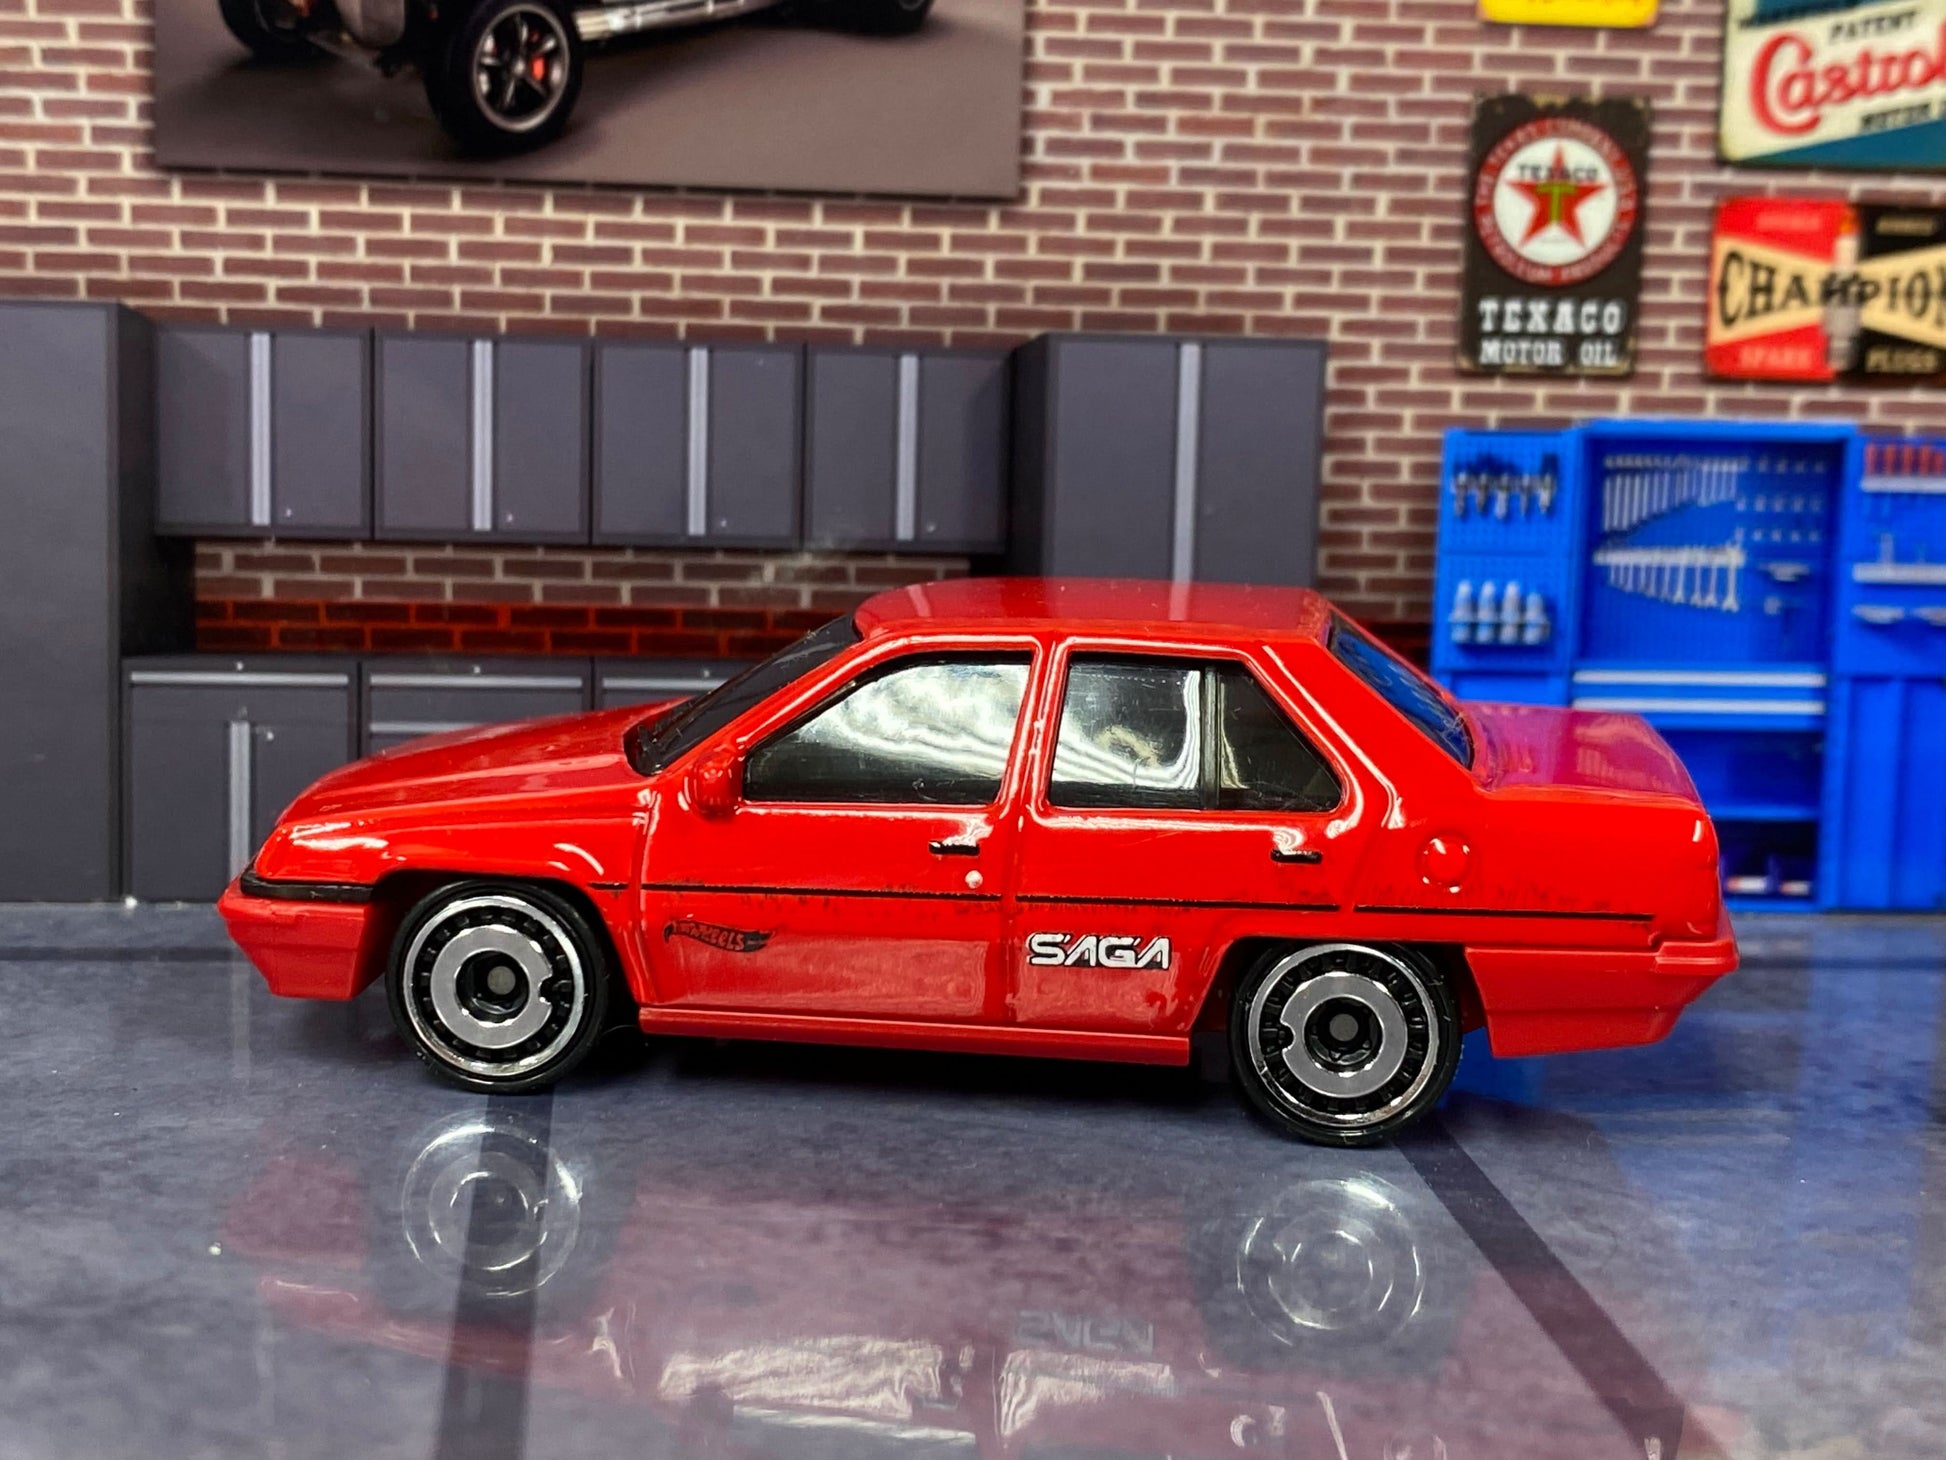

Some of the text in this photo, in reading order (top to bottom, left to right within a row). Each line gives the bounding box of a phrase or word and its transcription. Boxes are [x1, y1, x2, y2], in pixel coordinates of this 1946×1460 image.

[1829, 9, 1918, 44] PATENT
[1478, 298, 1623, 335] TEXACO
[1479, 339, 1618, 367] MOTOR OIL
[1025, 931, 1171, 970] SAGA
